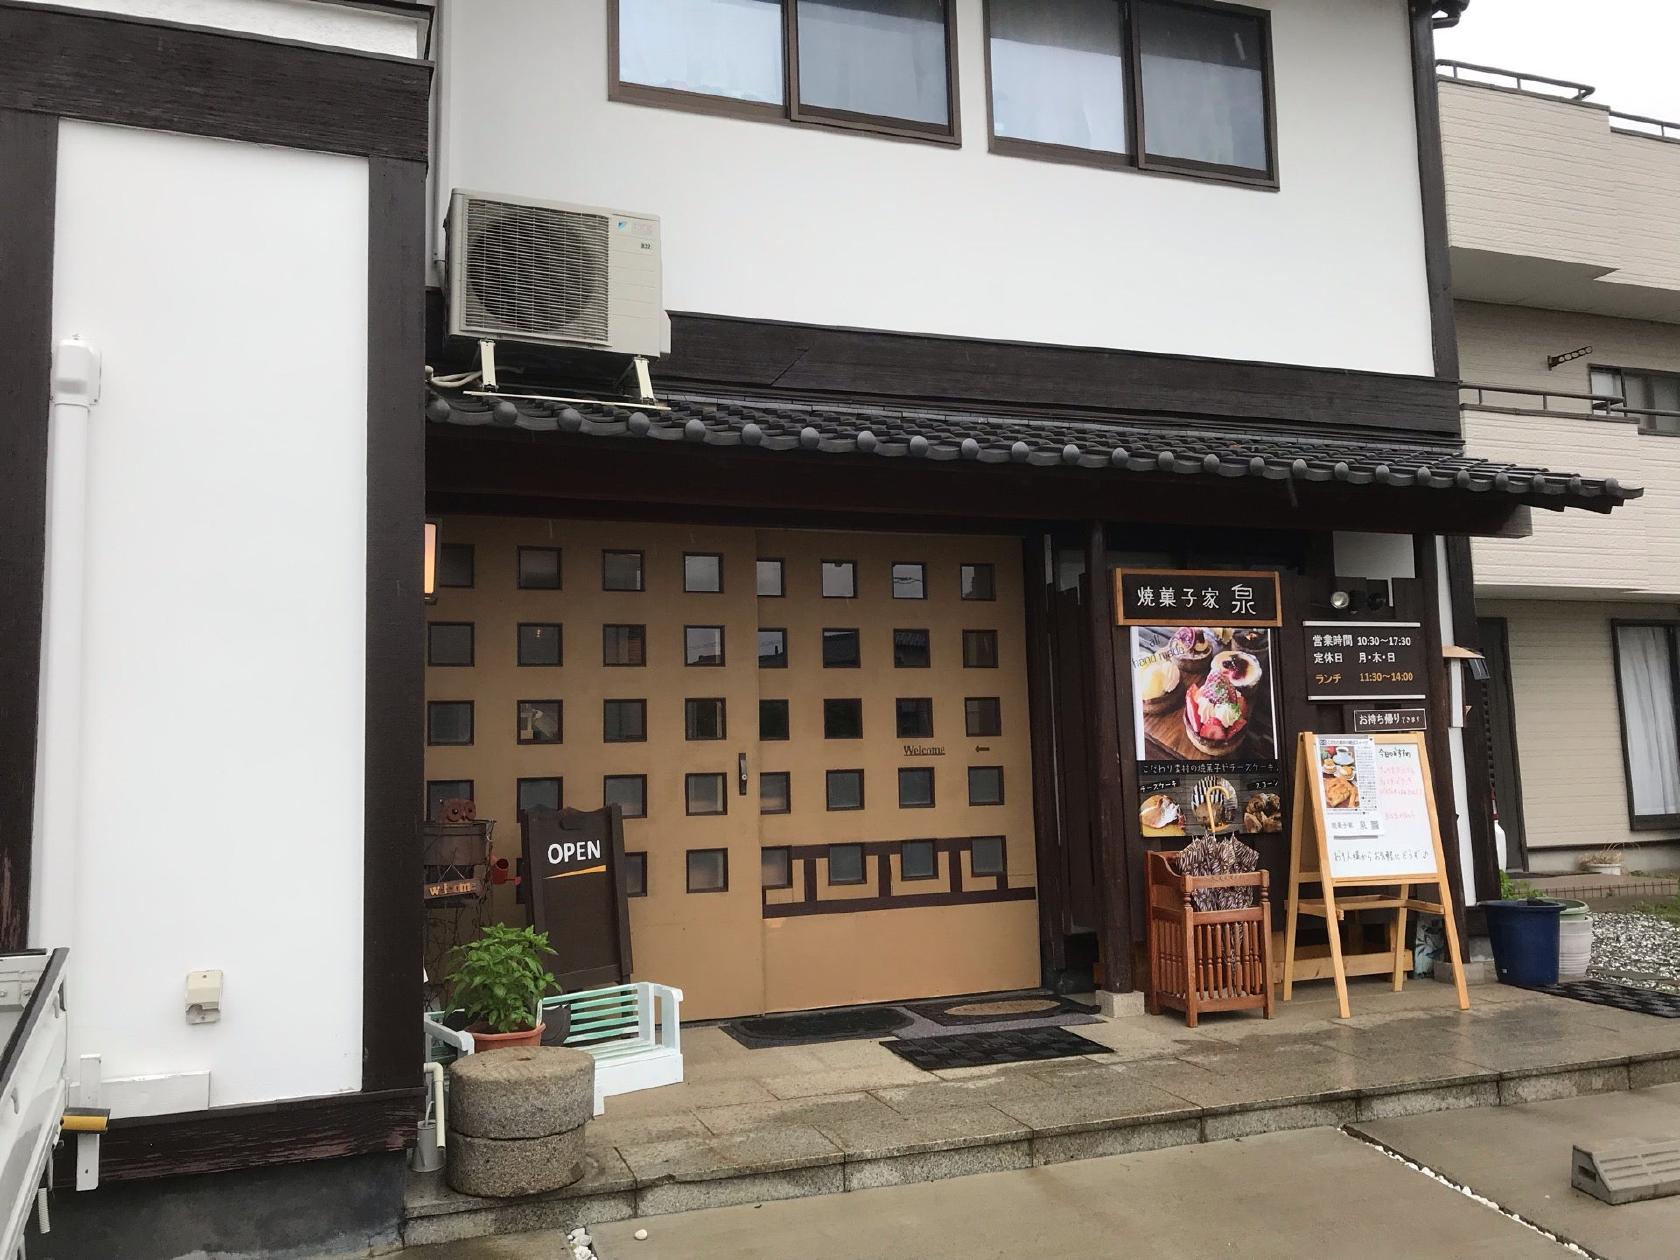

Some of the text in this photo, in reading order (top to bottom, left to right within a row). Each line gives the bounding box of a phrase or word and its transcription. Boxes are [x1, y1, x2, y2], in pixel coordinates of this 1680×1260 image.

[1137, 583, 1257, 615] 焼菓子家 泉
[1312, 634, 1353, 647] 営業時間
[1313, 652, 1396, 664] 定休日 月・木・日
[1315, 673, 1342, 685] ランチ
[903, 745, 946, 757] Welcome
[547, 839, 601, 864] OPEN
